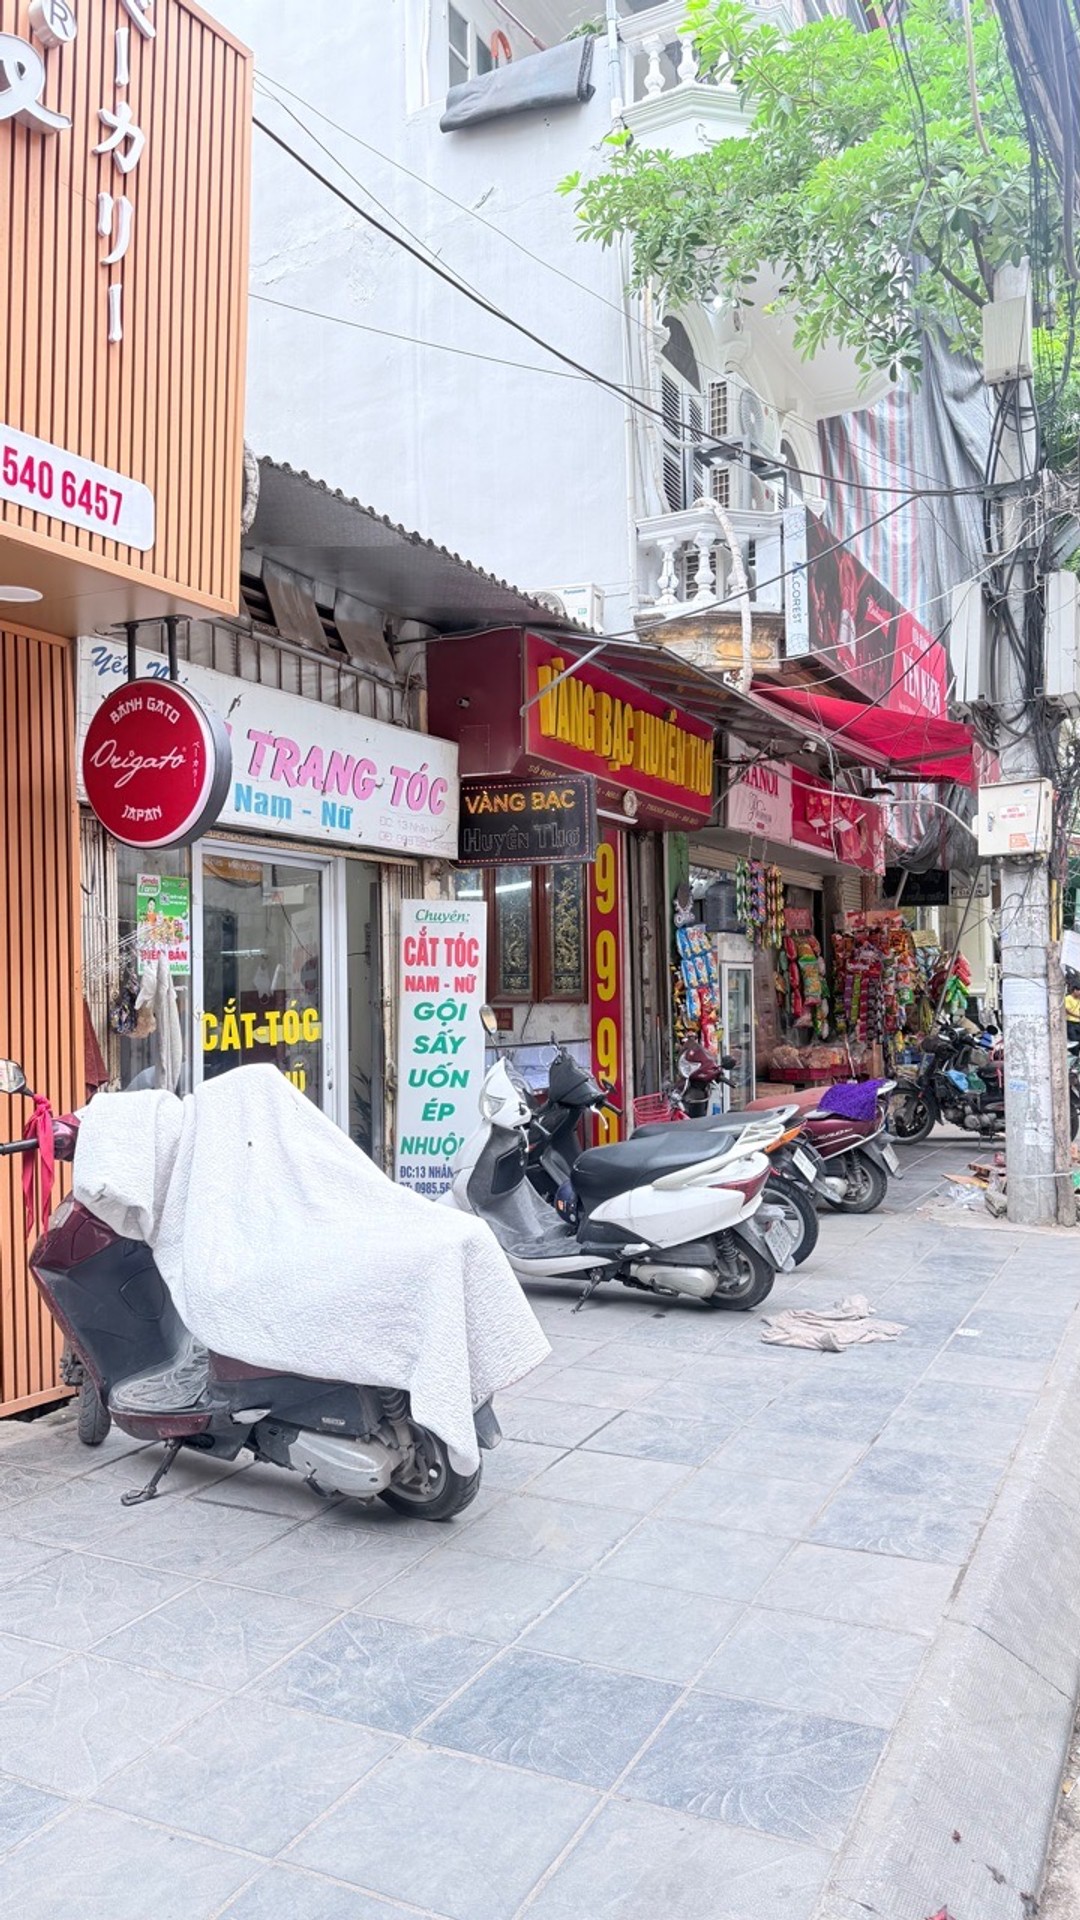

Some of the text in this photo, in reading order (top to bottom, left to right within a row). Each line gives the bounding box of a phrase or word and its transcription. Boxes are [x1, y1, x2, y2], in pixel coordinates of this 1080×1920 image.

[2, 445, 123, 527] 540 6457
[109, 697, 180, 725] BÁNH GATO
[537, 656, 595, 752] VÀNG
[595, 691, 634, 772] BẠC
[90, 740, 186, 789] Origato
[247, 728, 448, 815] TRANG TÓC
[121, 805, 163, 822] JAPAN
[235, 782, 292, 820] Nam
[464, 790, 526, 814] VÀNG
[531, 788, 576, 812] BẠC
[533, 821, 581, 849] Thơ
[415, 908, 470, 923] Chuyên:
[168, 946, 187, 961] BÁN
[403, 925, 480, 968] CẮT TÓC
[405, 975, 439, 993] NAM
[454, 973, 477, 994] NỮ
[413, 998, 467, 1027] GỘI
[412, 1029, 466, 1056] SẤY
[408, 1062, 470, 1089] UỐN
[421, 1097, 455, 1122] ÉP
[400, 1131, 465, 1161] NHUỘ
